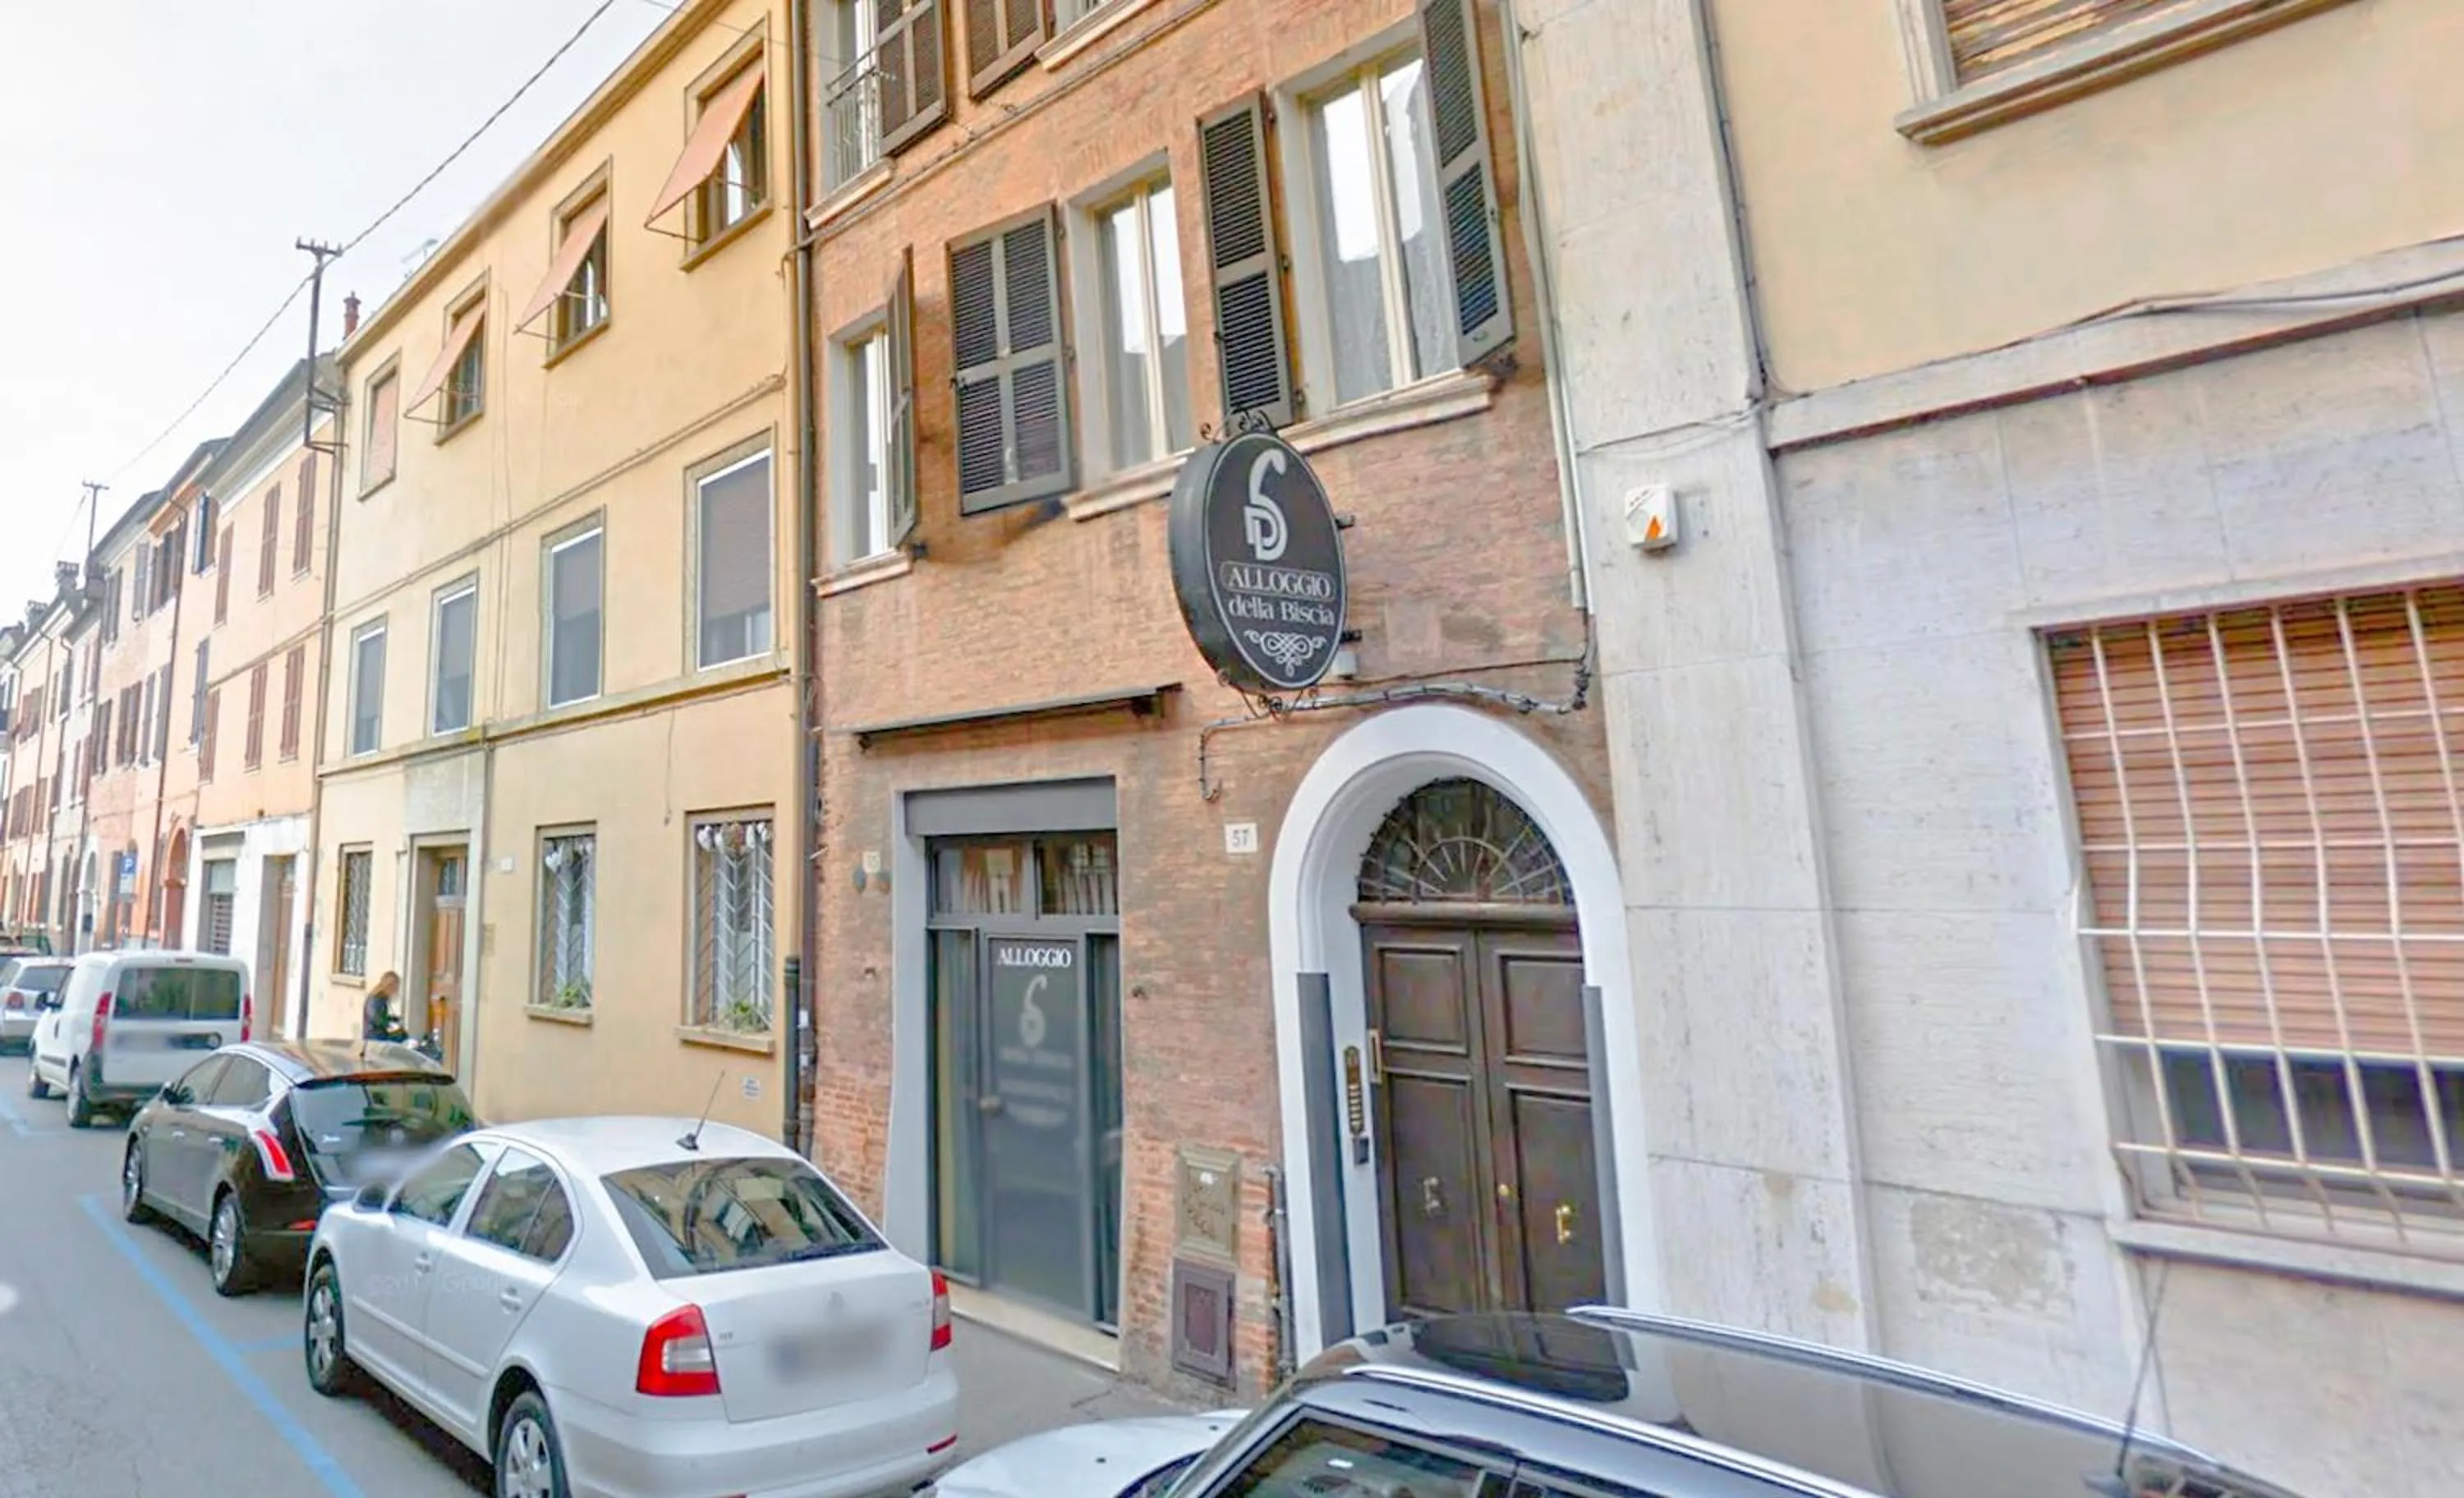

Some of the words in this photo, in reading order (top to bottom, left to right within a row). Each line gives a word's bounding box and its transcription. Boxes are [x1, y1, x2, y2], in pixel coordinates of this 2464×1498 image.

[1229, 566, 1331, 598] ALLOGGIO
[1229, 594, 1275, 620] della
[1281, 600, 1335, 626] Biscia
[1232, 828, 1249, 848] 57
[996, 947, 1072, 968] ALLOGGIO
